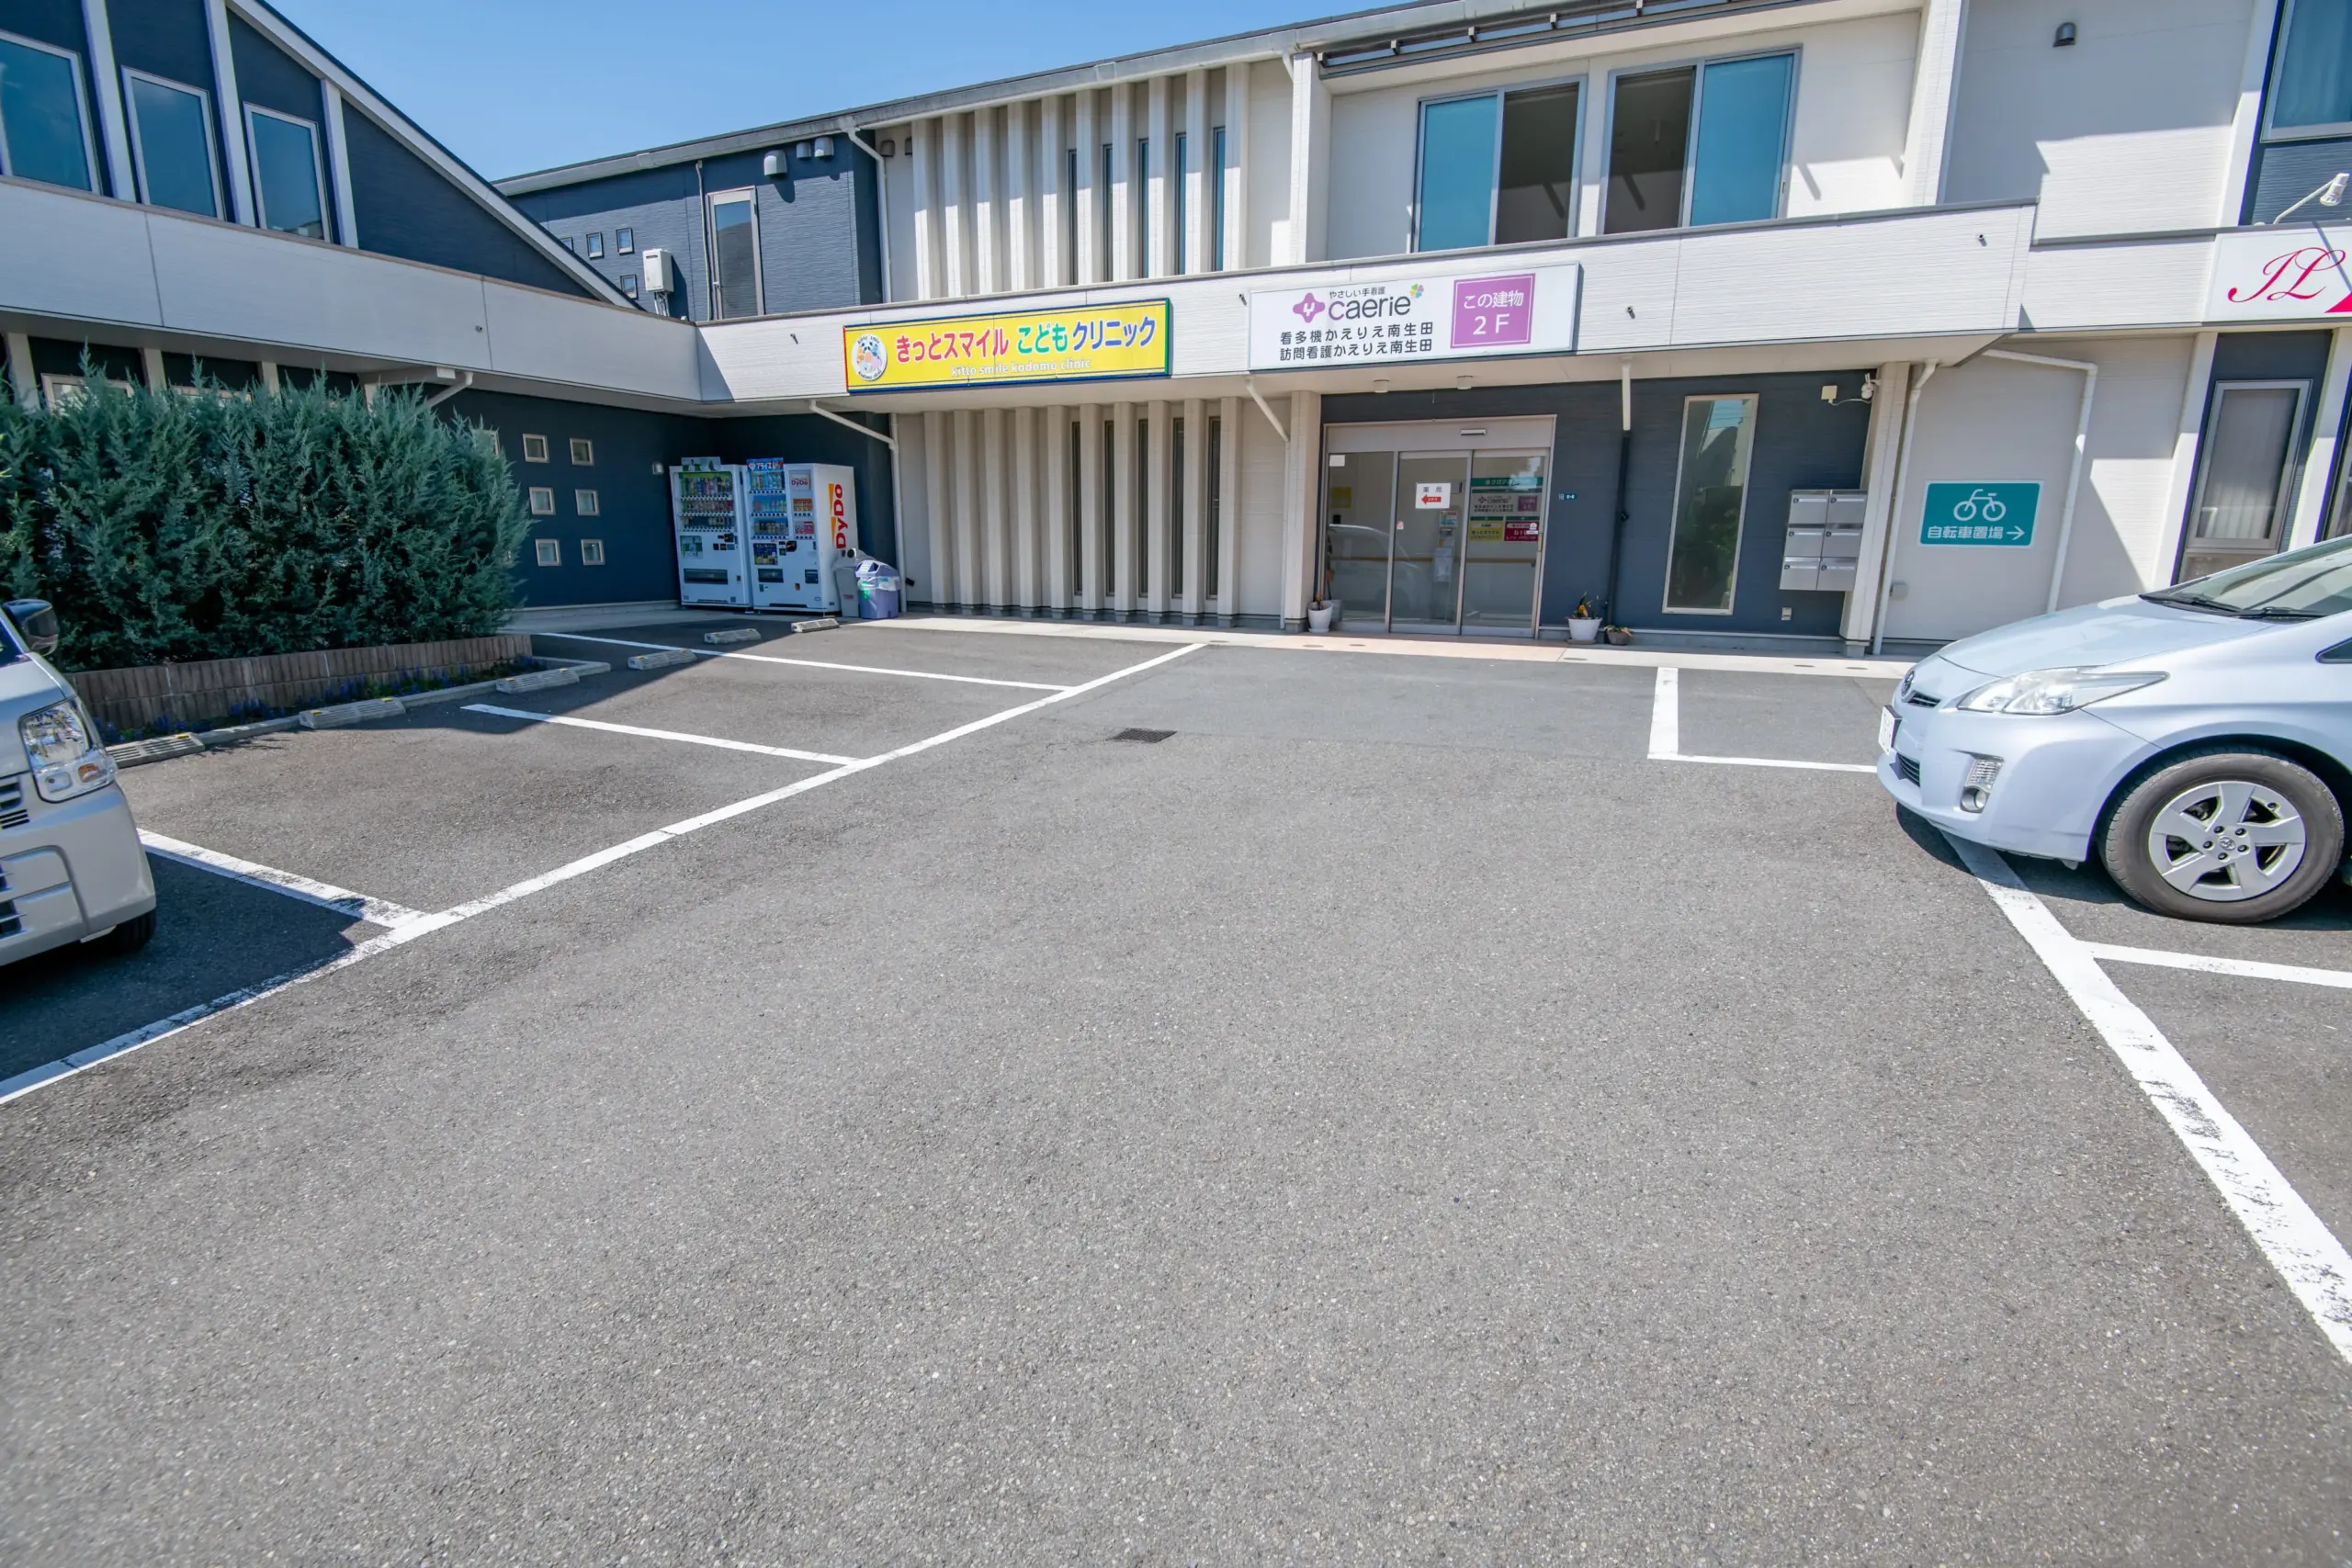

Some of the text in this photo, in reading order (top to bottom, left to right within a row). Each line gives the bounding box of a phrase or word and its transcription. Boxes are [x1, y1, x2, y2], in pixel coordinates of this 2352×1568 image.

[1329, 286, 1386, 299] やさしい手看護
[1464, 289, 1525, 310] この建物
[1328, 296, 1411, 321] caerie
[896, 315, 1156, 363] きっとスマイル こどもクリニック
[1280, 321, 1434, 345] 看多機かえりえ南生田
[1279, 338, 1433, 362] 訪問看護かえりえ南生田
[951, 357, 1091, 378] kitto smile kodomo clinic
[791, 479, 808, 488] DyDo
[833, 483, 849, 549] DyDo
[1927, 525, 2004, 539] 自転車置場
